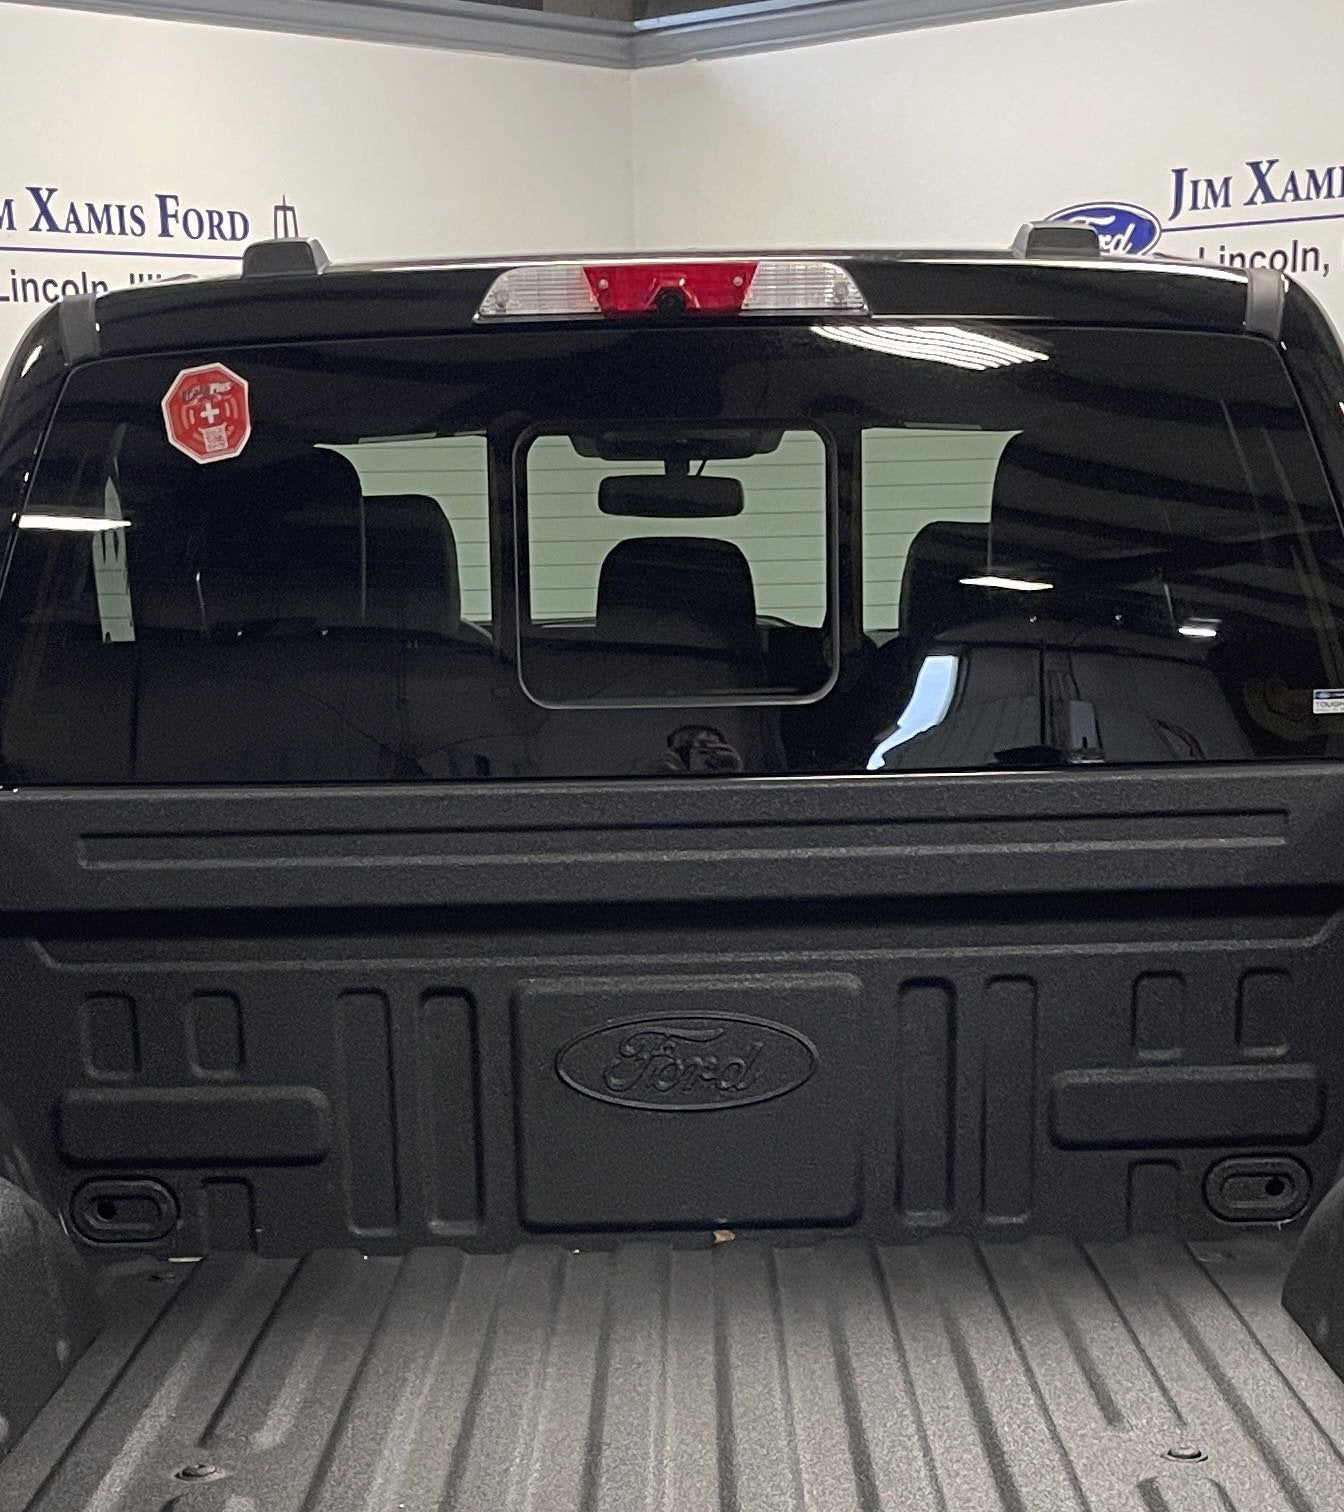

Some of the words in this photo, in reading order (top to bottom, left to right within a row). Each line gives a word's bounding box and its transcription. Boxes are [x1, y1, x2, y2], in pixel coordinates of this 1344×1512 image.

[25, 186, 146, 237] XAMIS
[155, 193, 250, 241] FORD
[1168, 168, 1233, 221] JIM
[603, 1025, 765, 1093] Ford
